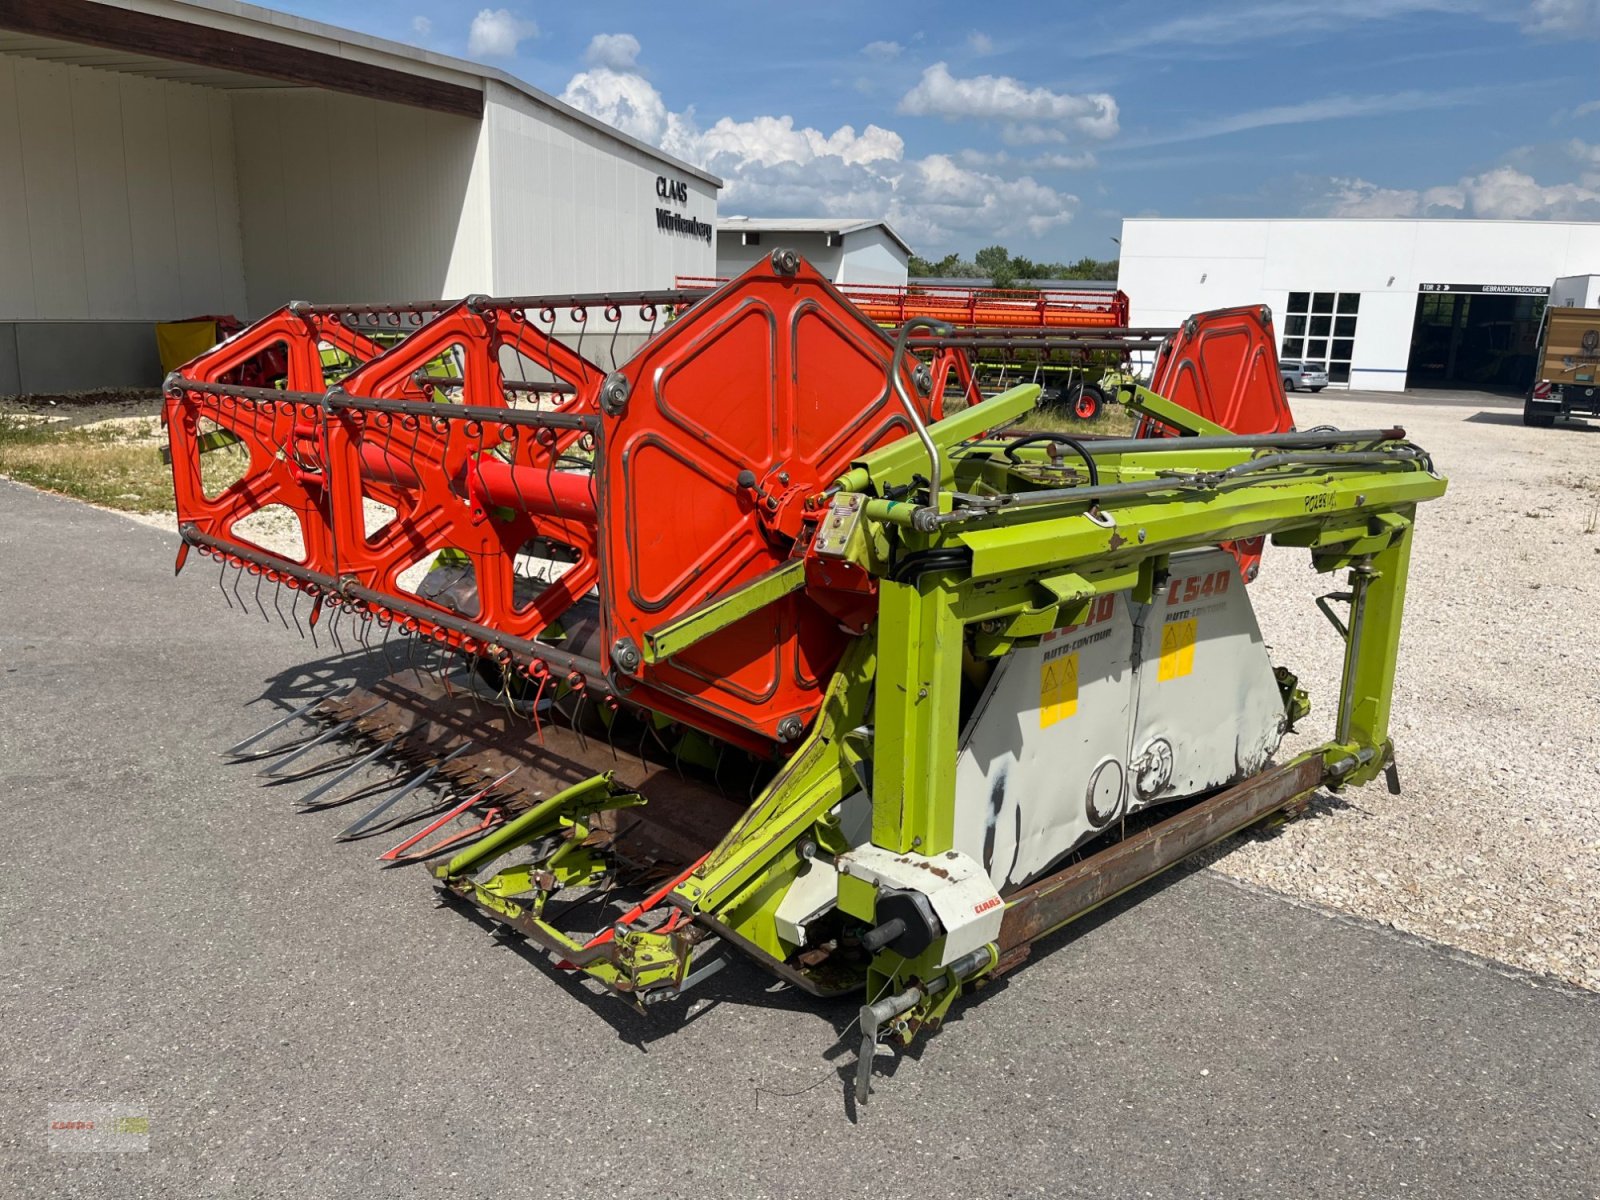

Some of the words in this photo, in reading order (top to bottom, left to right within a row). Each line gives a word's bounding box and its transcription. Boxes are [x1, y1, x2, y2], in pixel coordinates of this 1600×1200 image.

[656, 176, 687, 202] CLAAS
[656, 208, 712, 242] Württemberg
[1482, 285, 1547, 294] GEBRAUCHTMASCHINEN
[1044, 629, 1112, 661] AUTO-CONTOUR
[974, 896, 1001, 913] CLAAS
